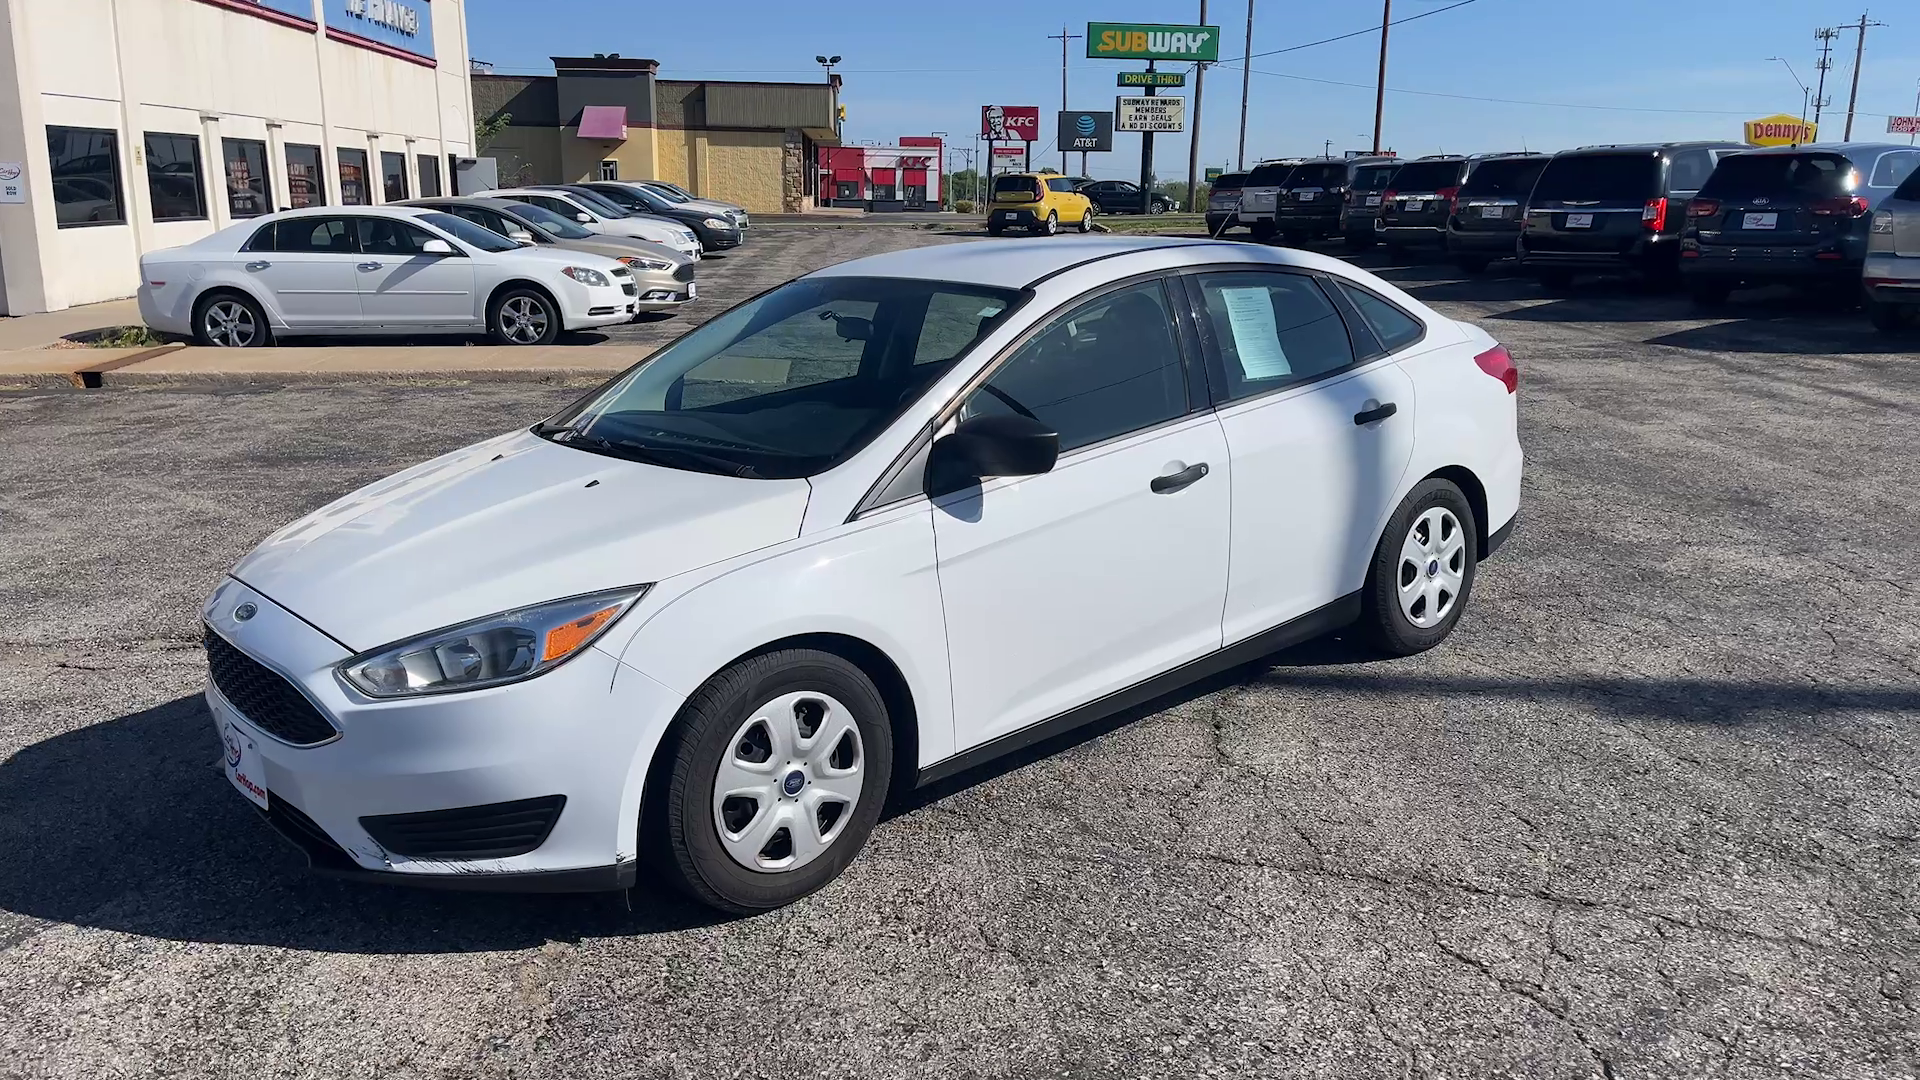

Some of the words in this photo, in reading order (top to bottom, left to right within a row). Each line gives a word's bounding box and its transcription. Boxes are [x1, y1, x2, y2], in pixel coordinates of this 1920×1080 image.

[1097, 30, 1210, 53] SUBWAY
[1125, 75, 1152, 84] DRIVE
[1157, 75, 1181, 84] THRU
[1005, 116, 1035, 127] KFC
[1892, 118, 1914, 126] JOHN
[1073, 138, 1097, 148] AT&T
[899, 156, 932, 168] KFC
